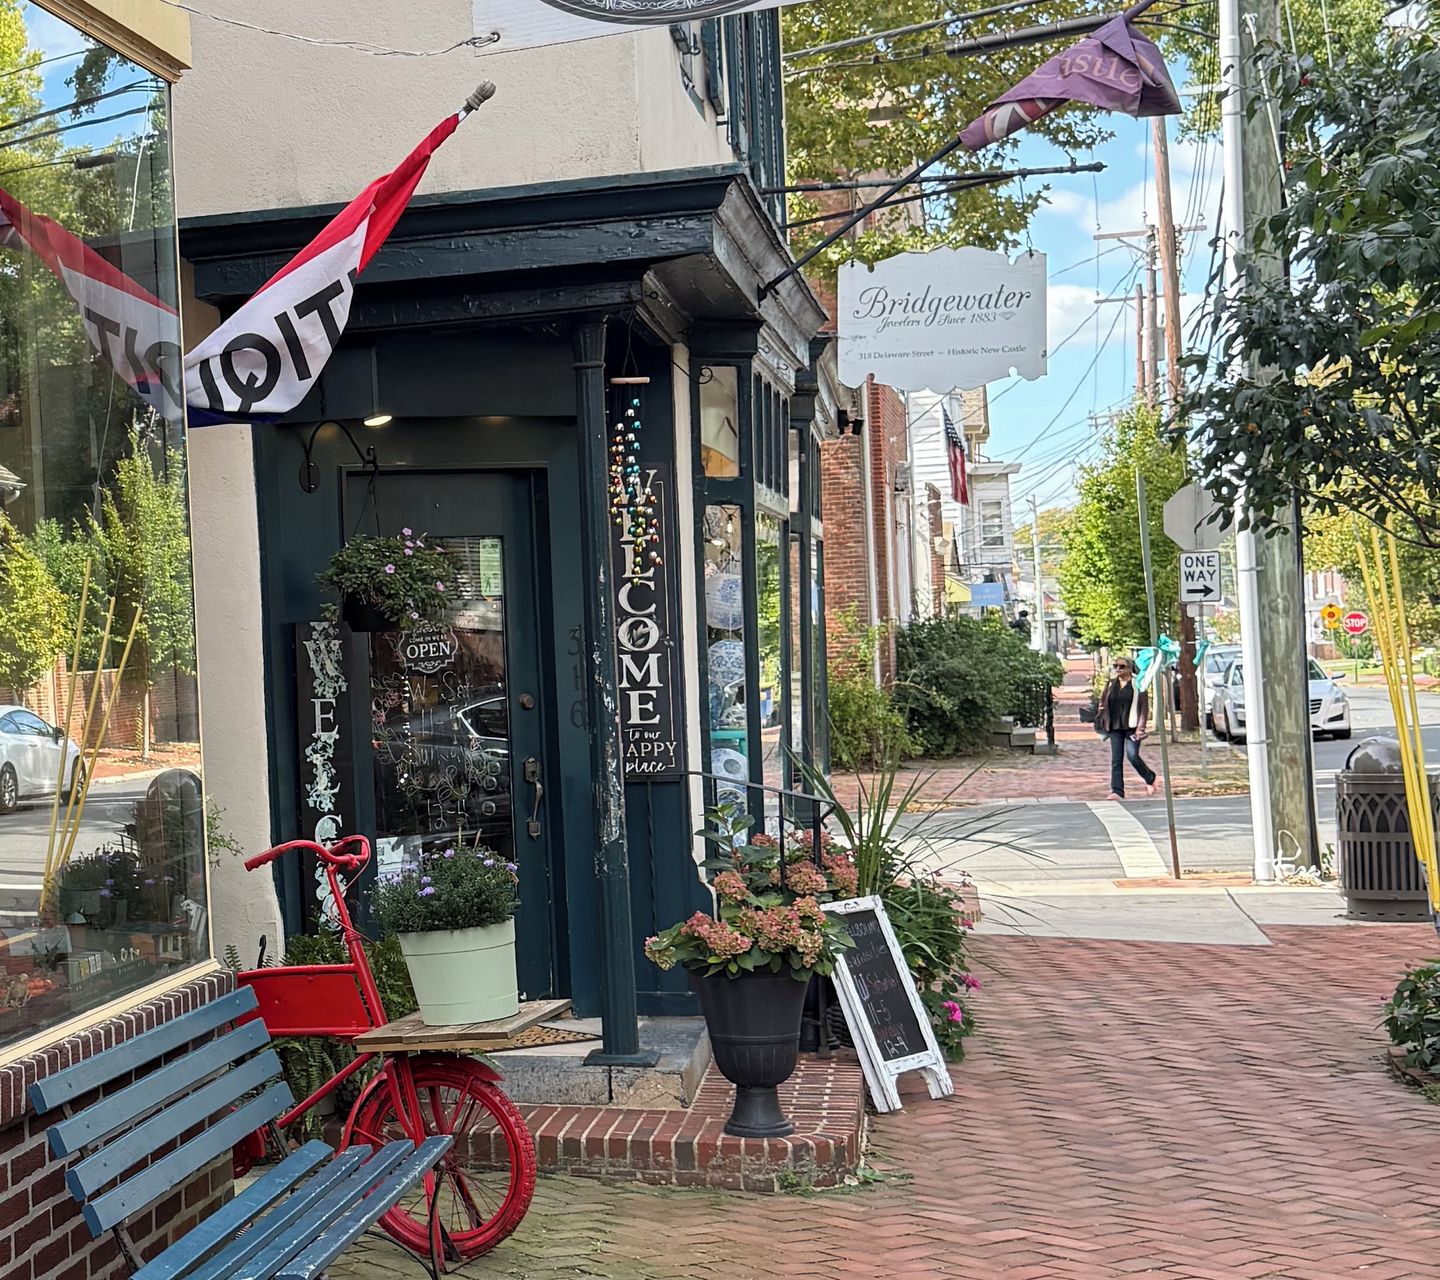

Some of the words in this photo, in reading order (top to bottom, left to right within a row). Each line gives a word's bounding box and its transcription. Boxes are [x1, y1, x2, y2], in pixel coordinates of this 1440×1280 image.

[852, 284, 1031, 327] Bridgewater
[876, 316, 921, 333] Jewelers
[970, 311, 997, 324] 1883
[873, 350, 911, 360] Delaware
[911, 349, 935, 358] Street
[947, 348, 980, 357] Historic
[981, 346, 1000, 355] New
[1001, 344, 1027, 354] Castle
[1184, 555, 1216, 568] ONE
[1184, 570, 1216, 582] WAY
[1345, 618, 1366, 627] STOP
[406, 641, 451, 659] OPEN
[644, 730, 661, 740] our
[620, 741, 677, 758] APPY
[625, 758, 666, 775] place
